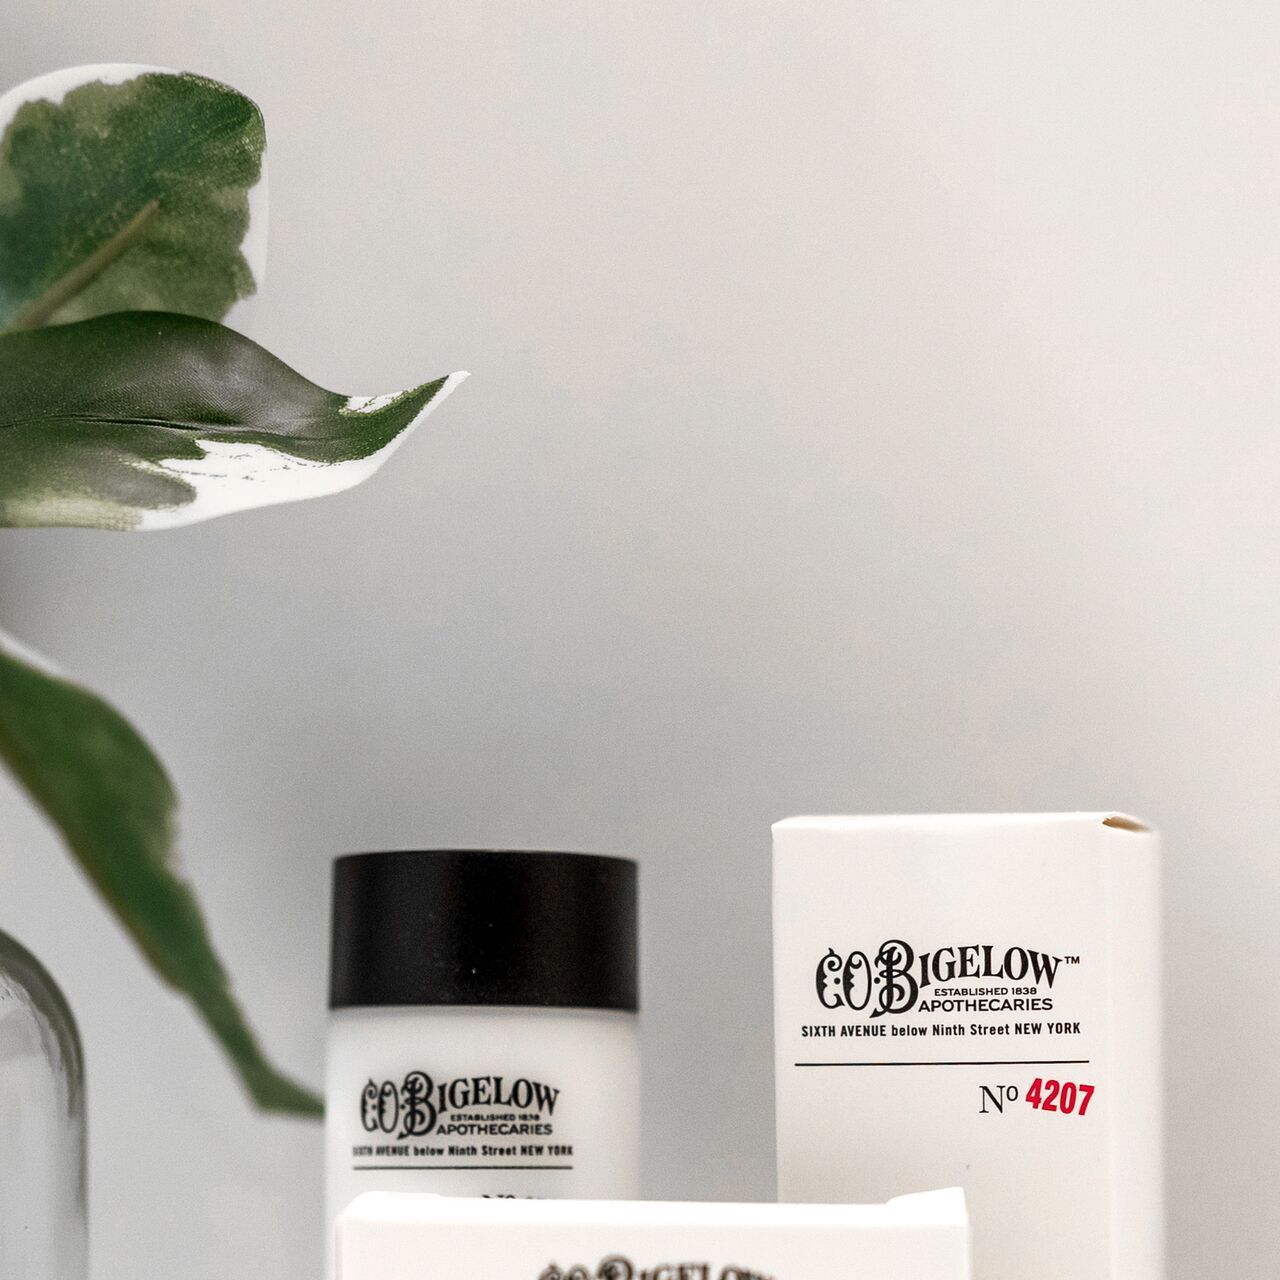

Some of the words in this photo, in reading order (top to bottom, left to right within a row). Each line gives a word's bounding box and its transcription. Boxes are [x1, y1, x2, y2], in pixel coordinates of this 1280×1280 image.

[868, 938, 1062, 1019] BIGELOW
[934, 987, 1009, 997] ESTABLISHED
[1011, 986, 1038, 996] 1838
[917, 997, 1054, 1013] APOTHECARIES
[801, 1025, 836, 1038] SIXTH
[840, 1024, 887, 1038] AVENUE
[891, 1024, 928, 1037] below
[932, 1023, 965, 1037] Ninth
[969, 1023, 1010, 1036] Street
[1014, 1022, 1043, 1035] NEW
[1046, 1021, 1081, 1035] YORK
[1025, 1077, 1096, 1116] 4207
[397, 1070, 560, 1140] BIGELOW
[450, 1113, 517, 1122] ESTABLISHED
[436, 1122, 553, 1136] APOTHECARIES
[375, 1145, 410, 1157] AVENUE
[413, 1145, 445, 1157] below
[447, 1145, 478, 1156] Ninth
[481, 1144, 517, 1157] Street
[520, 1144, 544, 1157] NEW
[547, 1144, 573, 1157] YORK
